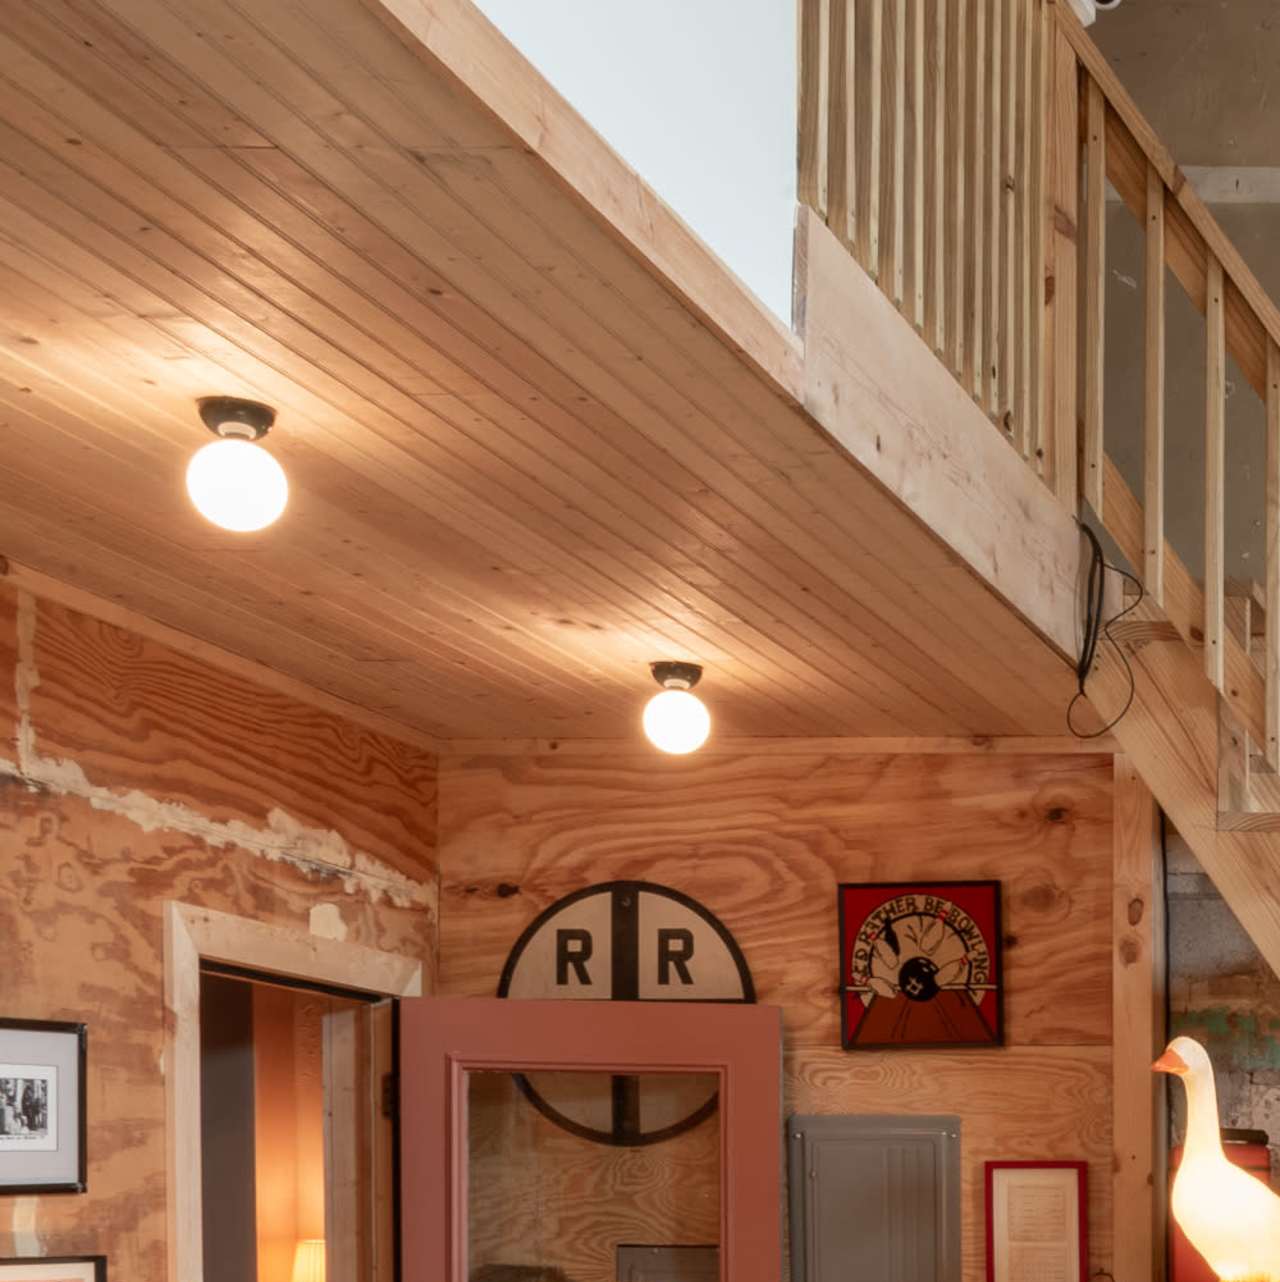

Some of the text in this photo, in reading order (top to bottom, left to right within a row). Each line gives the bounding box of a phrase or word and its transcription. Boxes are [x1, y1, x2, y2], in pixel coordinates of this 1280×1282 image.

[555, 928, 695, 986] R R
[923, 897, 945, 915] BE
[949, 908, 989, 985] BOWLING
